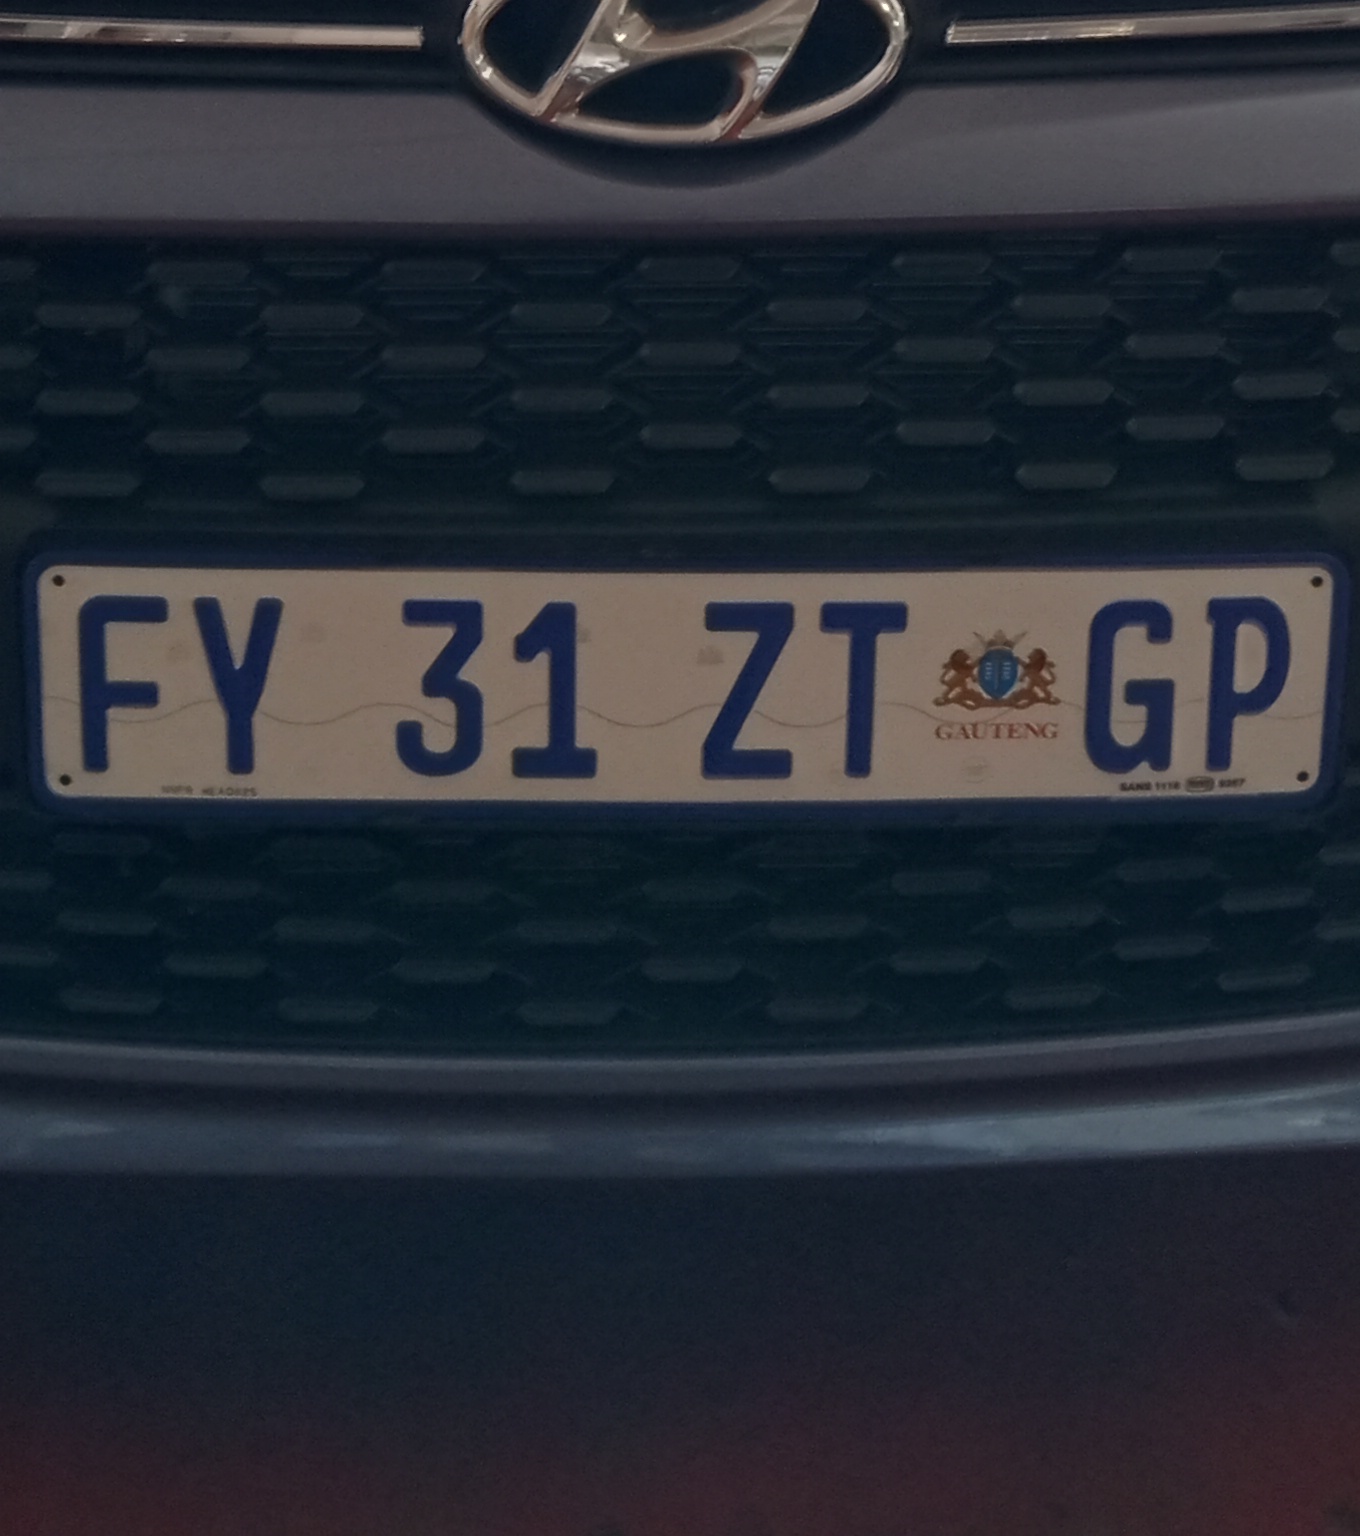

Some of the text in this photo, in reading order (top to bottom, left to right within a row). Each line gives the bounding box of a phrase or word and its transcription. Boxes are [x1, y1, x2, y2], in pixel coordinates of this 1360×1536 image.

[78, 595, 1292, 780] FY 31 ZT GP
[934, 721, 1059, 741] GAUTENG
